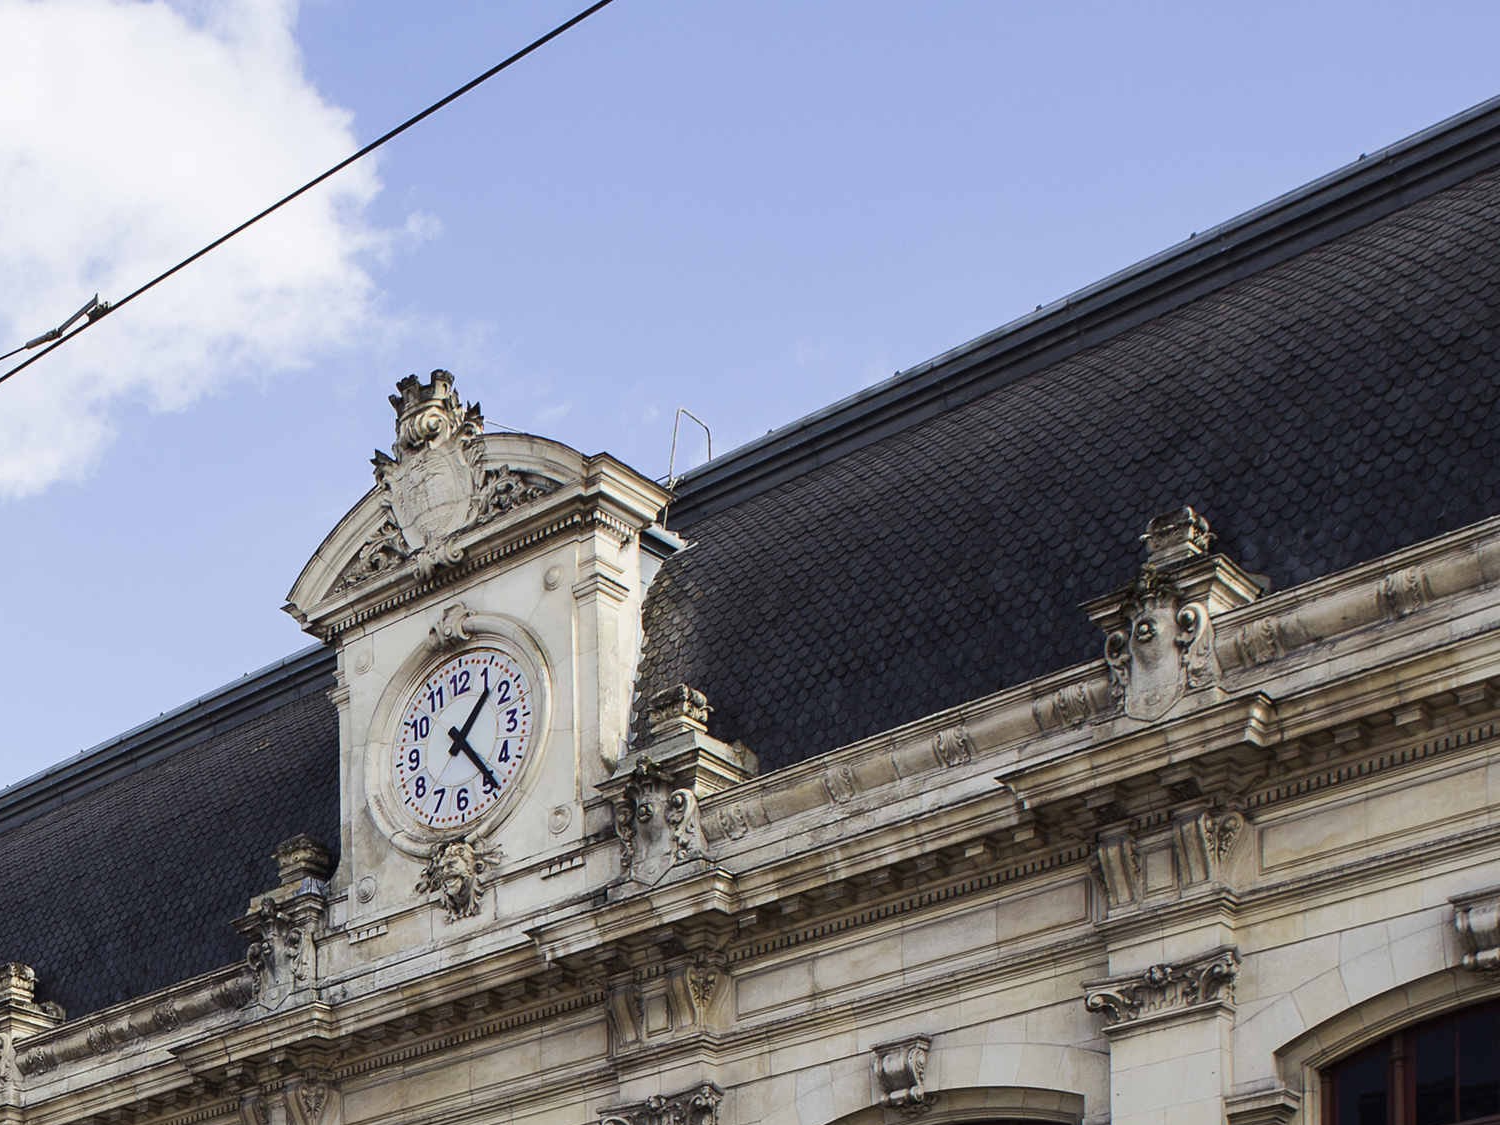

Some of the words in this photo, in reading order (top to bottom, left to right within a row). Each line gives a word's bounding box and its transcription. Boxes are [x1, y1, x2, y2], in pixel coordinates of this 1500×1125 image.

[450, 670, 470, 697] 12
[480, 667, 489, 690] 1
[427, 686, 444, 713] 11
[497, 680, 511, 705] 2
[410, 716, 430, 742] 10
[506, 708, 518, 733] 3
[408, 748, 420, 772] 9
[498, 739, 510, 764] 4
[414, 775, 426, 799] 8
[456, 787, 469, 811] 6
[433, 788, 446, 814] 7
